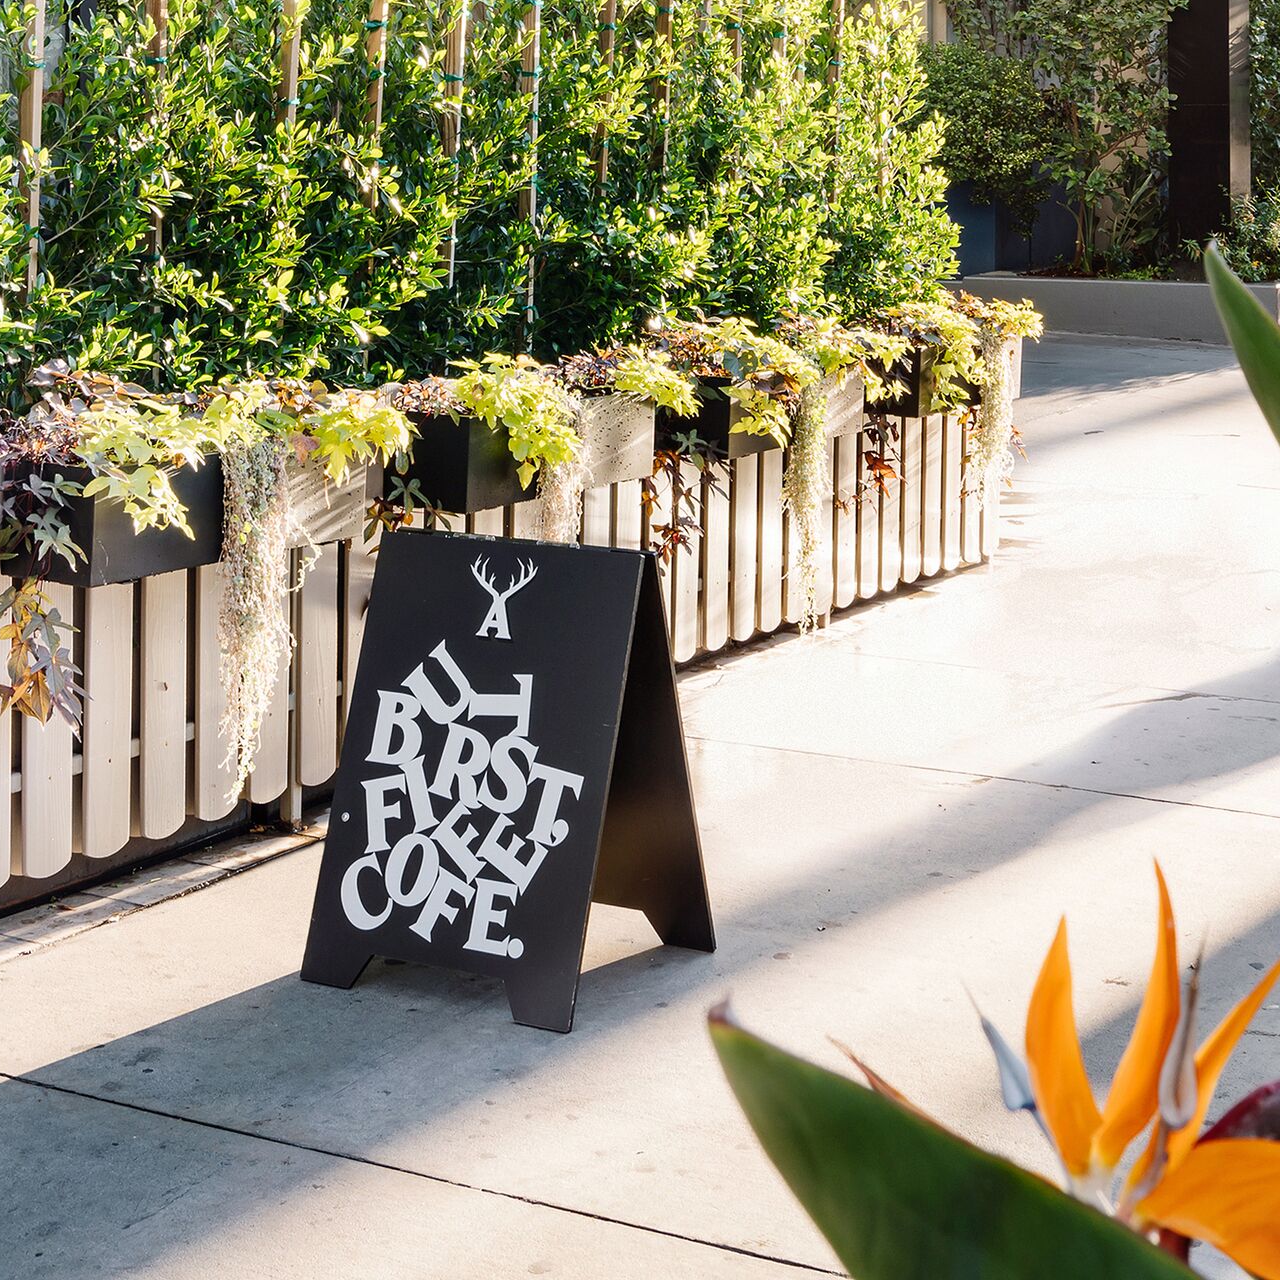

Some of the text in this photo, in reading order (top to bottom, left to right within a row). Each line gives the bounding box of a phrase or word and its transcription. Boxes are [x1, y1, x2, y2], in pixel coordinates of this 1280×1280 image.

[365, 639, 534, 767] BUT
[360, 722, 585, 854] FIRST,
[340, 803, 549, 960] COFFEE.
